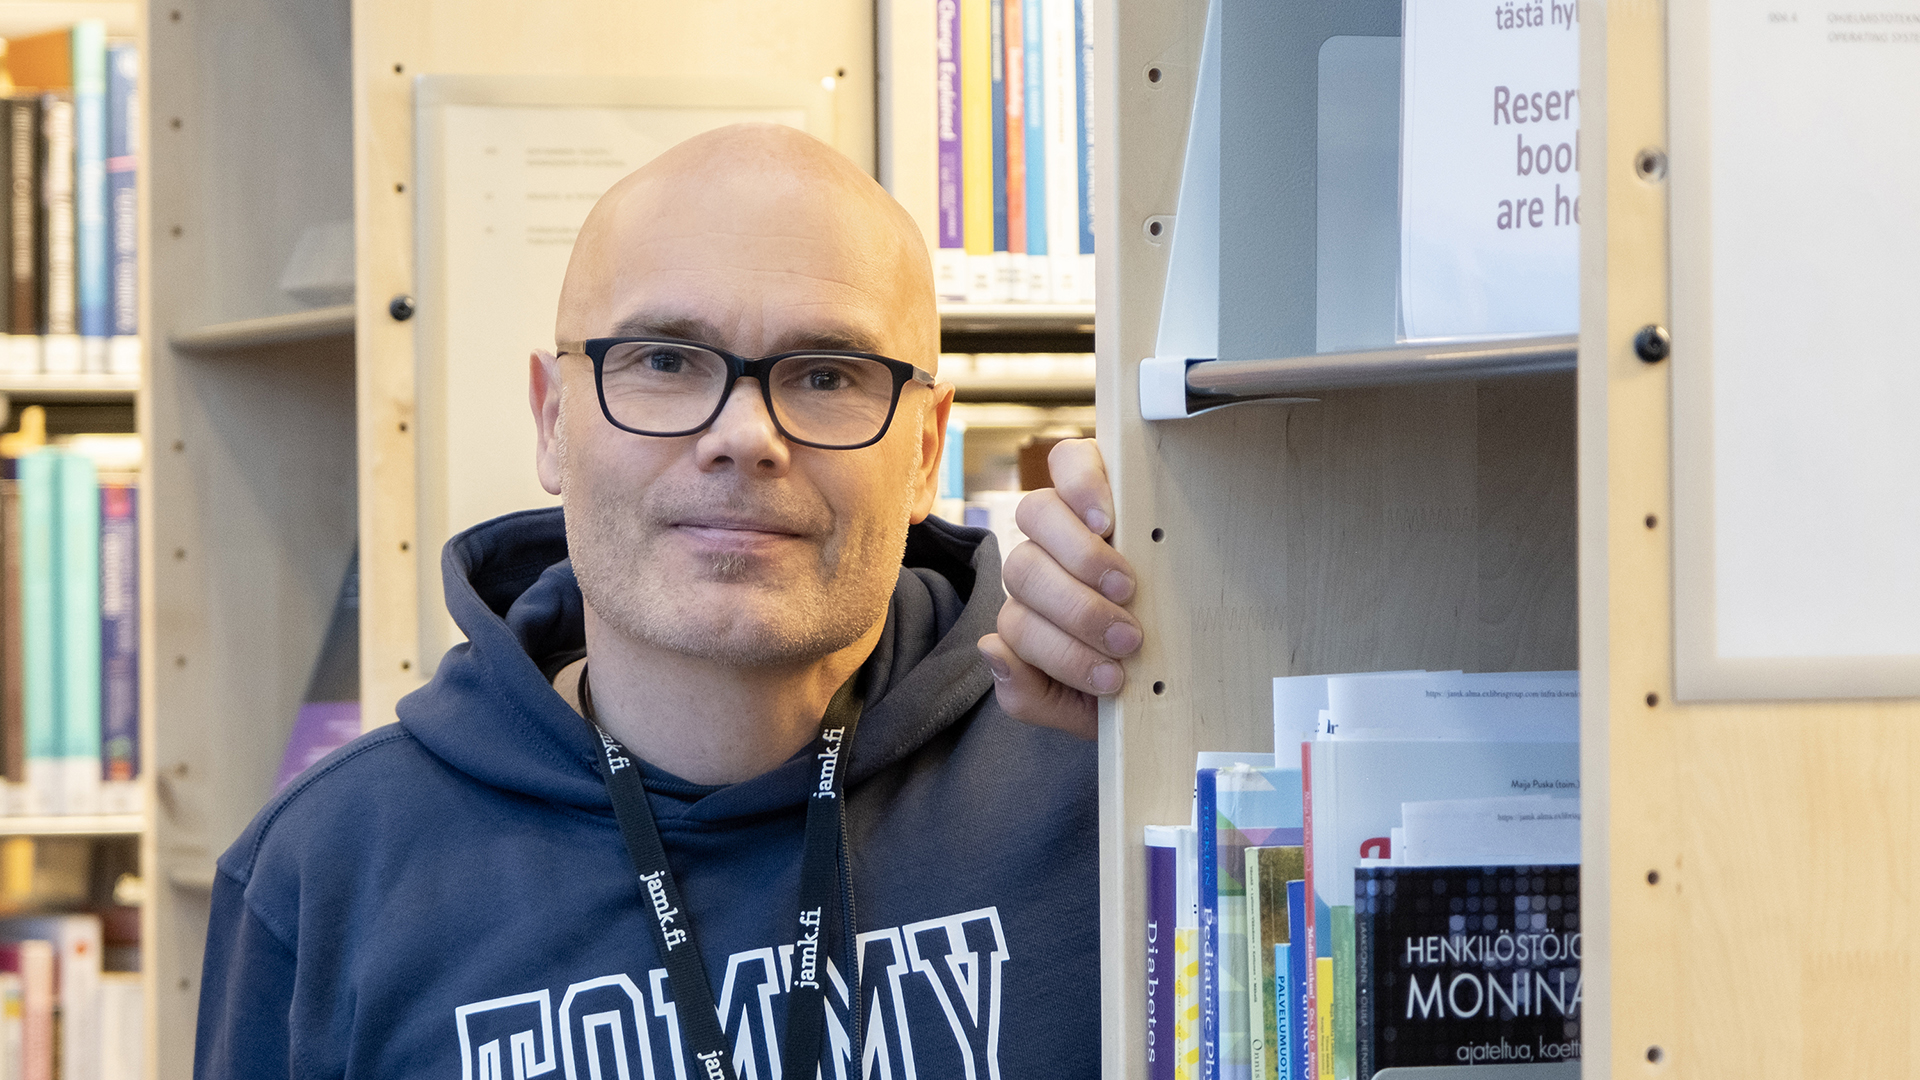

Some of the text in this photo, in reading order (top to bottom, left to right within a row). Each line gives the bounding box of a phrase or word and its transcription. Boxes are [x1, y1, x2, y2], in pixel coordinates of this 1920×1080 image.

[1496, 0, 1544, 30] tästä
[1494, 85, 1580, 126] Reser
[1497, 197, 1544, 230] are
[813, 726, 846, 799] jamk.fi
[1511, 780, 1531, 791] Maija
[1532, 779, 1553, 789] Puska
[639, 870, 687, 951] jamk.fi
[794, 906, 822, 989] jamk.fi
[1204, 907, 1214, 1031] Pediatric
[455, 905, 1010, 1080] TOMMY
[1147, 920, 1159, 1063] Diabetes
[1252, 1038, 1264, 1079] Onnis
[1457, 1034, 1582, 1065] ajateltua, koett
